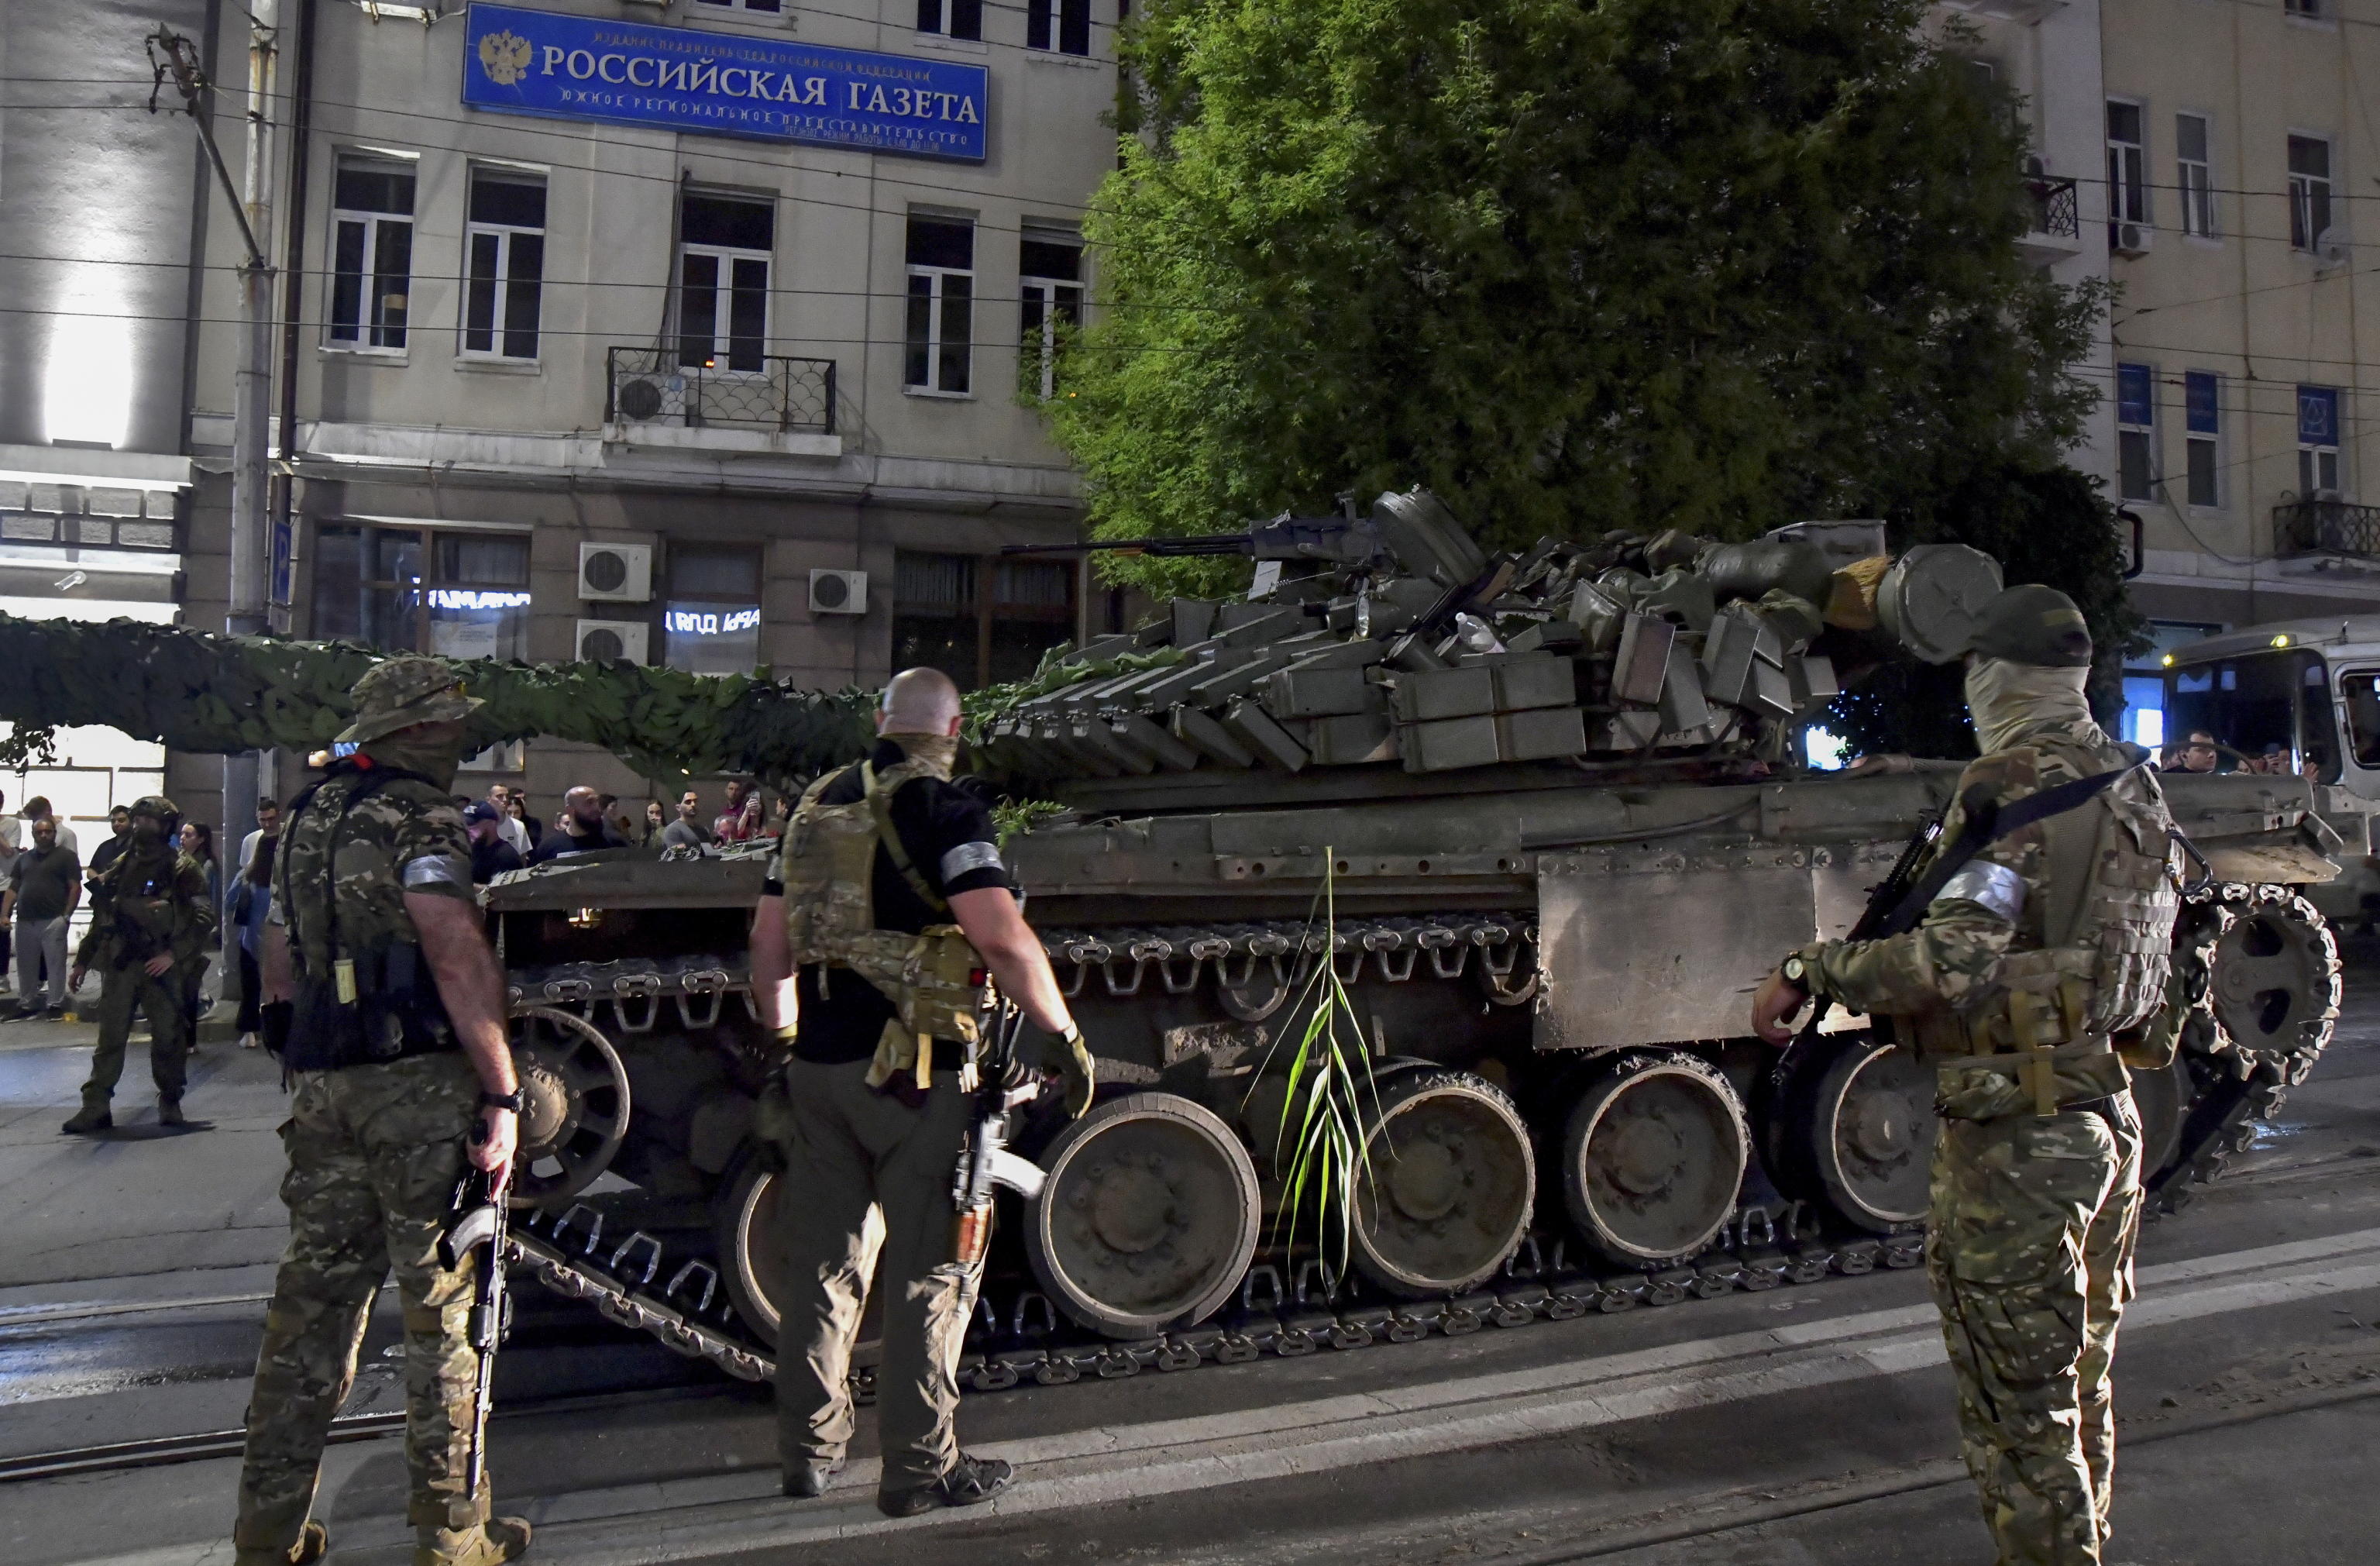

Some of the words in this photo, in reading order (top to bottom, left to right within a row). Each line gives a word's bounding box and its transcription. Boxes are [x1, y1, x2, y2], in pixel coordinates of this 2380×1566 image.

[542, 45, 827, 106] РОССИЙСКАЯ
[848, 81, 980, 124] ГАЗЕТА
[561, 88, 624, 107] ЮЖНОЕ
[635, 97, 771, 122] РЕГИОНАЛЬНОЕ
[782, 114, 968, 145] ПРЕДСТАВИТЕЛЬСТВО
